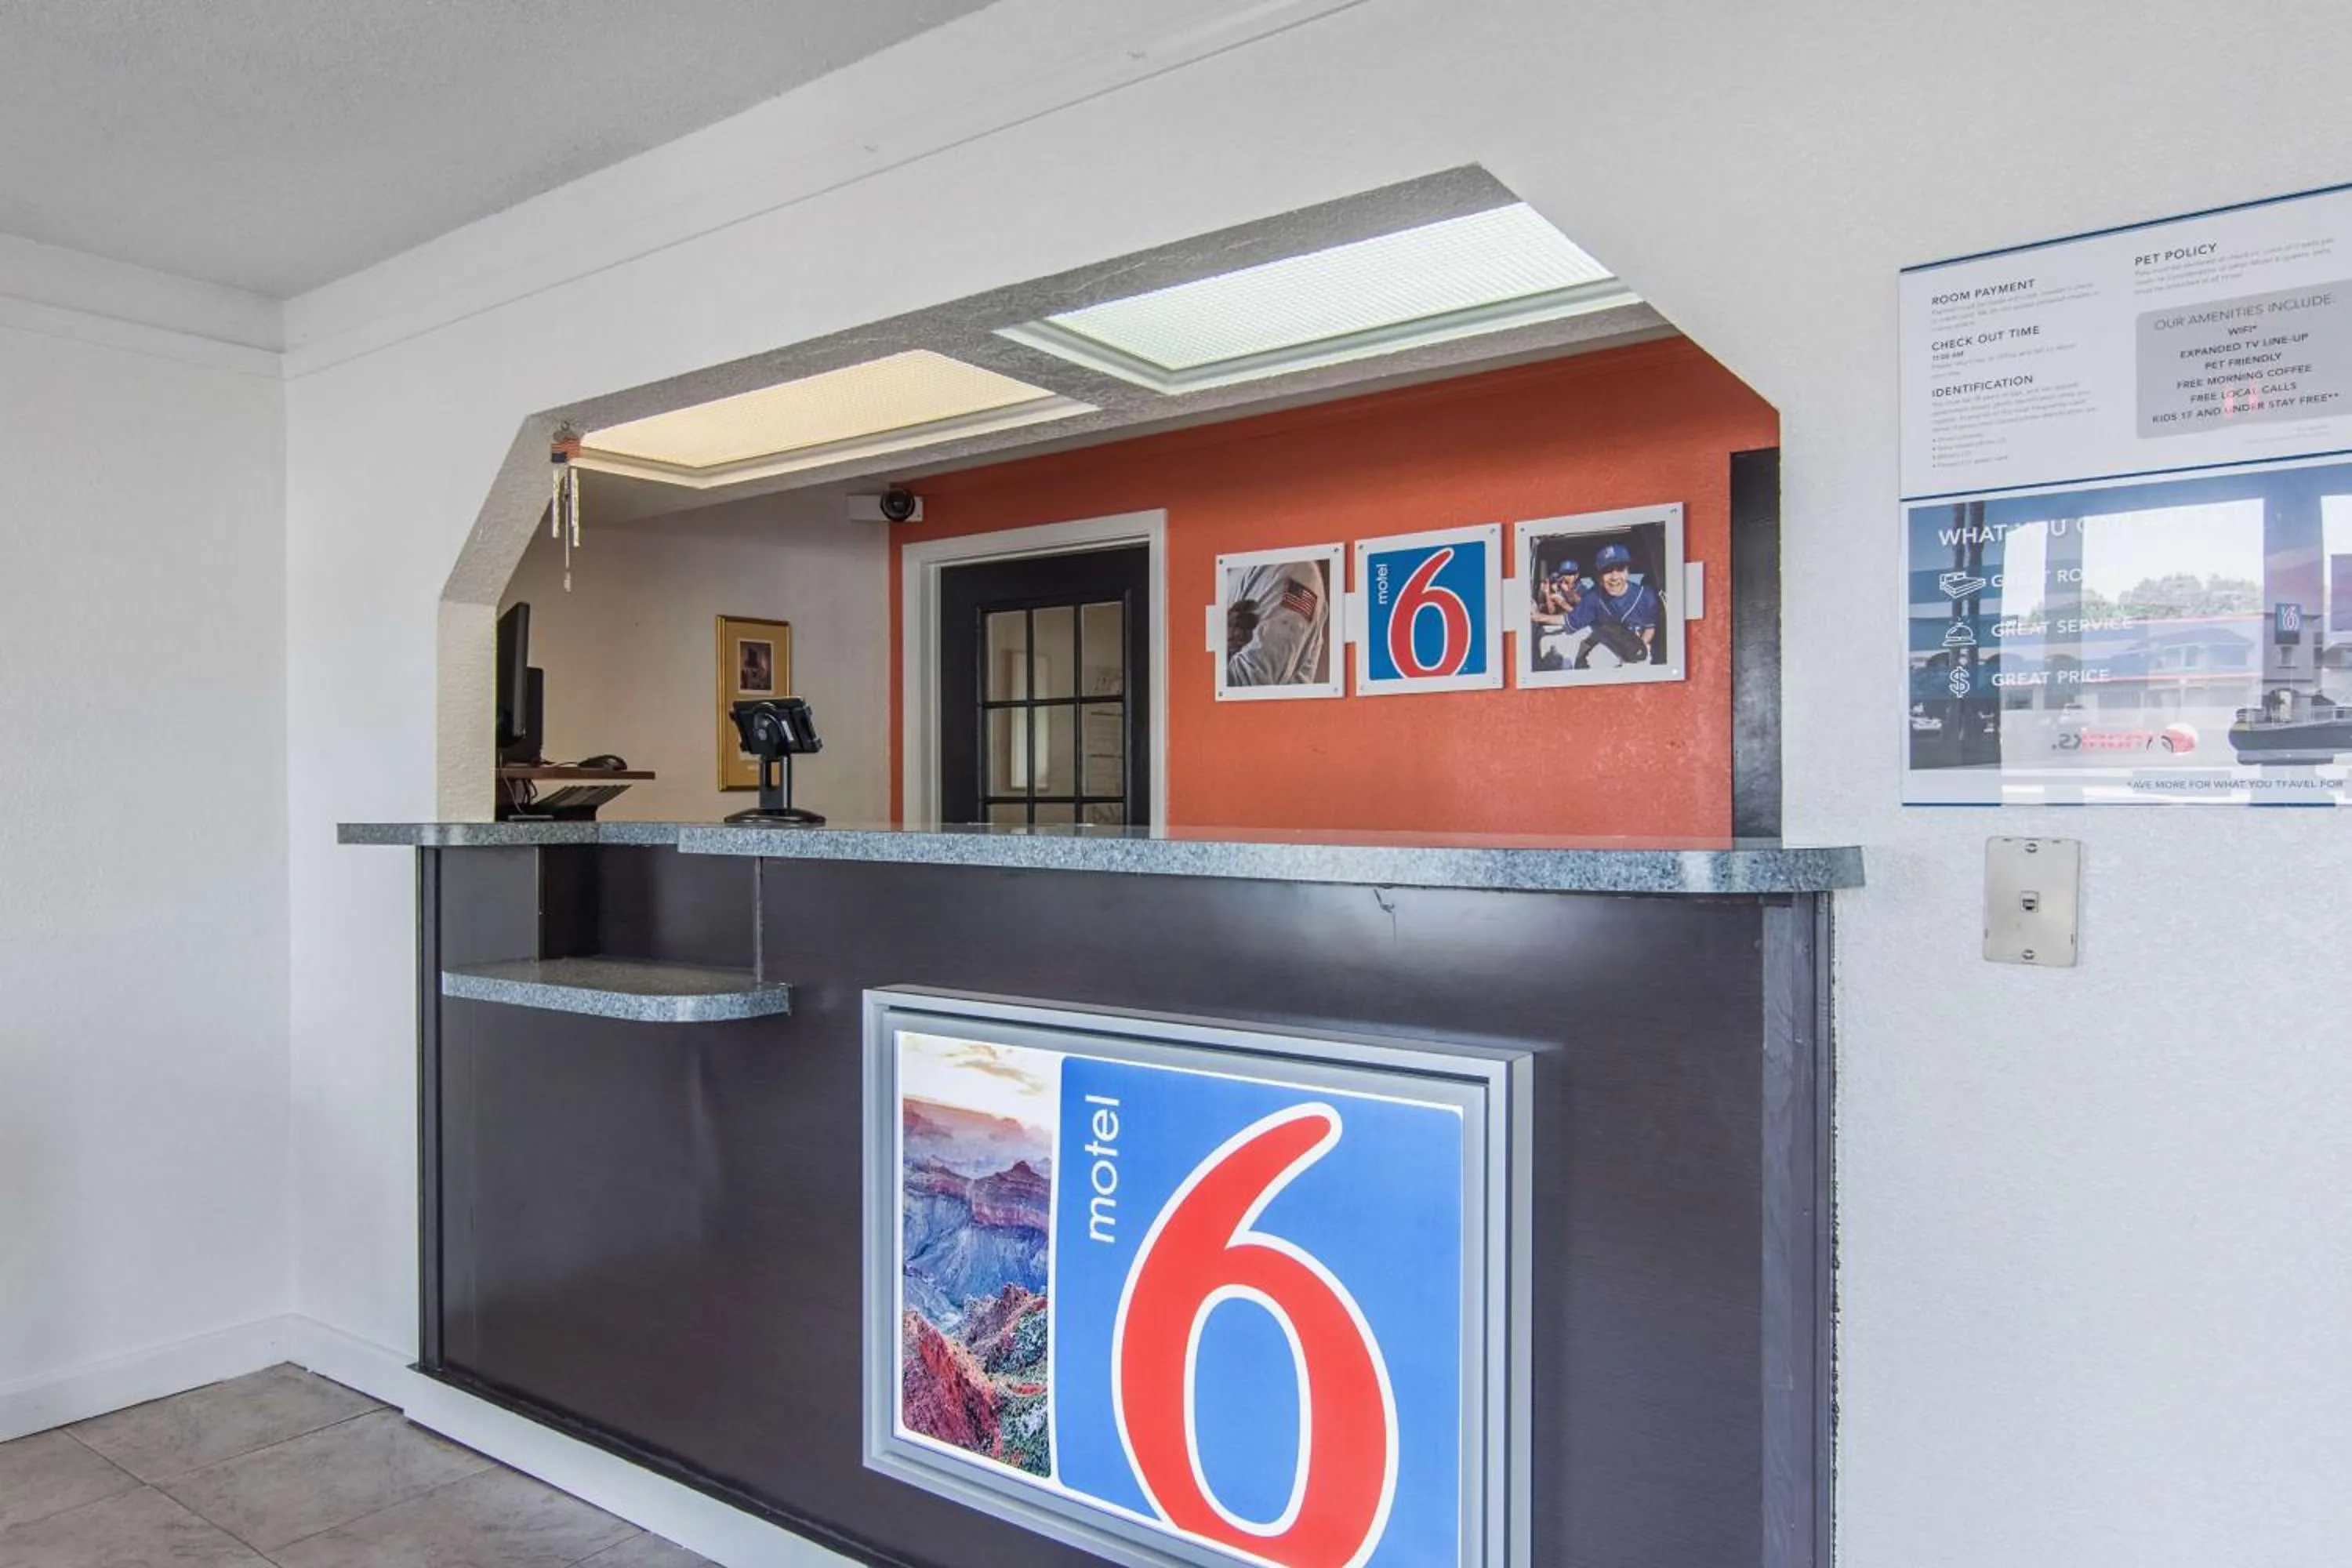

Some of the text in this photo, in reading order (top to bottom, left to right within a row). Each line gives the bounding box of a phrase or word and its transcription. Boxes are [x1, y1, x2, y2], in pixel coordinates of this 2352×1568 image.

[2134, 253, 2158, 266] PET
[2165, 242, 2217, 261] POLICY
[1931, 291, 1970, 305] ROOM
[1975, 278, 2036, 298] PAYMENT
[2154, 292, 2336, 331] OUR AMENITIES INCLUDE:
[1931, 325, 2040, 351] CHECK OUT TIME
[2180, 342, 2241, 358] EXPANDED
[2245, 340, 2259, 350] TV
[2205, 353, 2281, 369] PET FRIENDLY
[1931, 375, 2034, 397] IDENTIFICATION
[2177, 364, 2312, 390] FREE MORNING COFFEE
[2190, 393, 2217, 403] FREE
[2261, 382, 2297, 394] CALLS
[2152, 412, 2177, 423] KIDS
[2196, 407, 2221, 418] AND
[2268, 397, 2295, 409] STAY
[1938, 524, 2008, 546] WHAT
[1376, 547, 1472, 678] motel 6
[1991, 616, 2134, 637] GREAT SERVICE
[1991, 669, 2110, 686] GREAT PRICE
[2155, 779, 2187, 789] MORE
[2213, 779, 2246, 789] WHAT
[2249, 779, 2272, 789] YOU
[2319, 779, 2343, 788] FOR
[1084, 1094, 1399, 1568] motel 6
